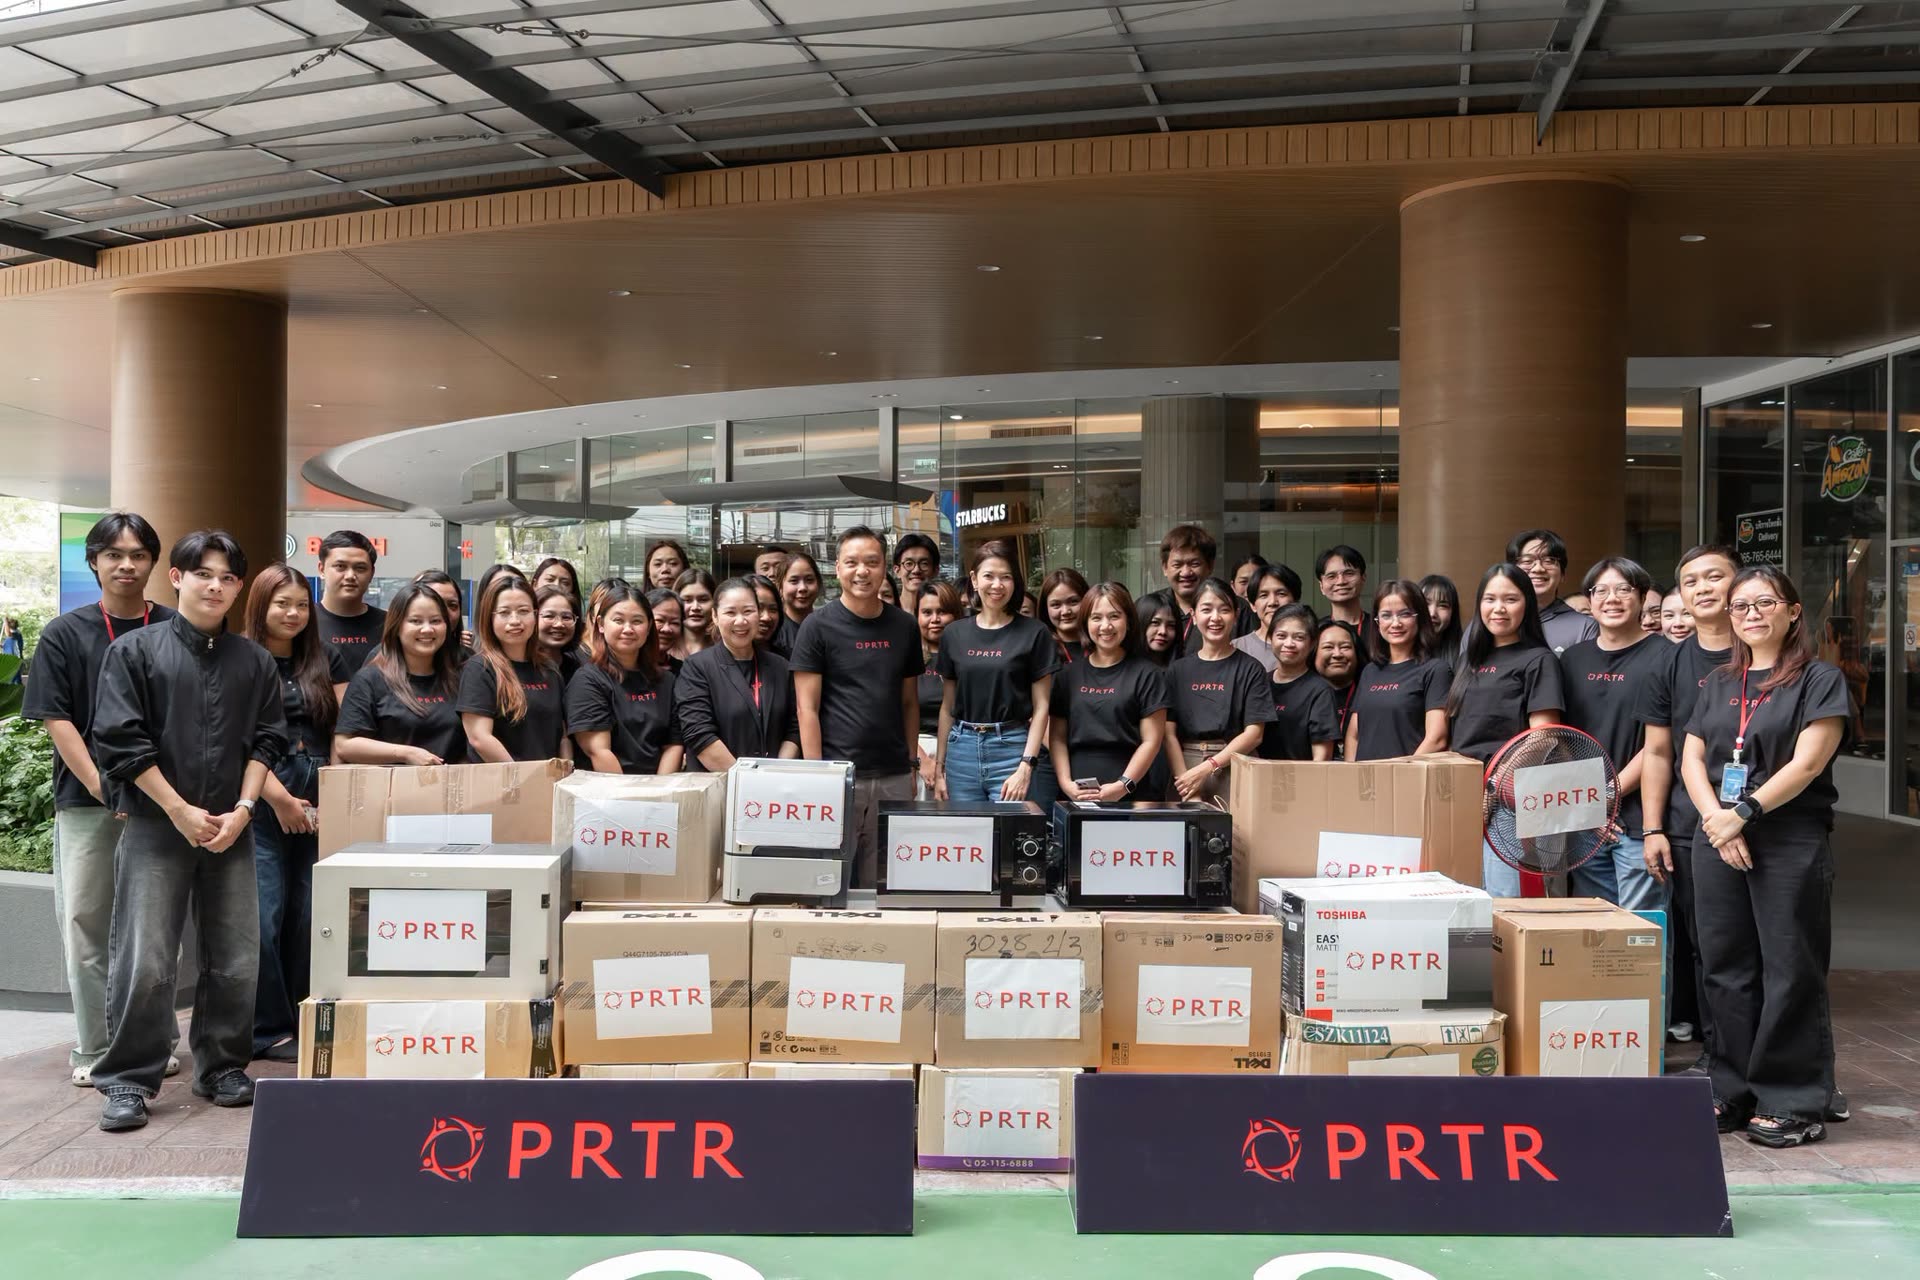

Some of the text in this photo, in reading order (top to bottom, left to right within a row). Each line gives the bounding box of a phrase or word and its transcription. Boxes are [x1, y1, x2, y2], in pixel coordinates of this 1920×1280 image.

[955, 503, 1006, 528] STARBUCKS
[1759, 533, 1779, 542] Delivery
[341, 636, 368, 644] PRTR
[864, 640, 891, 649] PRTR
[1596, 673, 1624, 682] PRTR
[1089, 687, 1115, 695] PRTR
[1199, 683, 1225, 691] PRTR
[1376, 683, 1399, 691] PRTR
[1543, 786, 1599, 809] PRTR
[768, 801, 834, 822] PRTR
[603, 829, 670, 849] PRTR
[919, 845, 985, 863] PRTR
[1113, 850, 1177, 867] PRTR
[1316, 910, 1367, 920] TOSHIBA
[403, 921, 477, 941] PRTR
[1316, 944, 1340, 952] MATT
[1371, 951, 1442, 970] PRTR
[629, 986, 704, 1008] PRTR
[822, 991, 895, 1014] PRTR
[1000, 991, 1071, 1009] PRTR
[1171, 998, 1243, 1017] PRTR
[402, 1035, 479, 1055] PRTR
[1572, 1030, 1641, 1050] PRTR
[1234, 1057, 1271, 1069] DELL
[979, 1110, 1052, 1129] PRTR
[508, 1120, 743, 1178] PRTR
[1325, 1122, 1559, 1180] PRTR
[974, 1159, 1034, 1168] 02-115-6888
